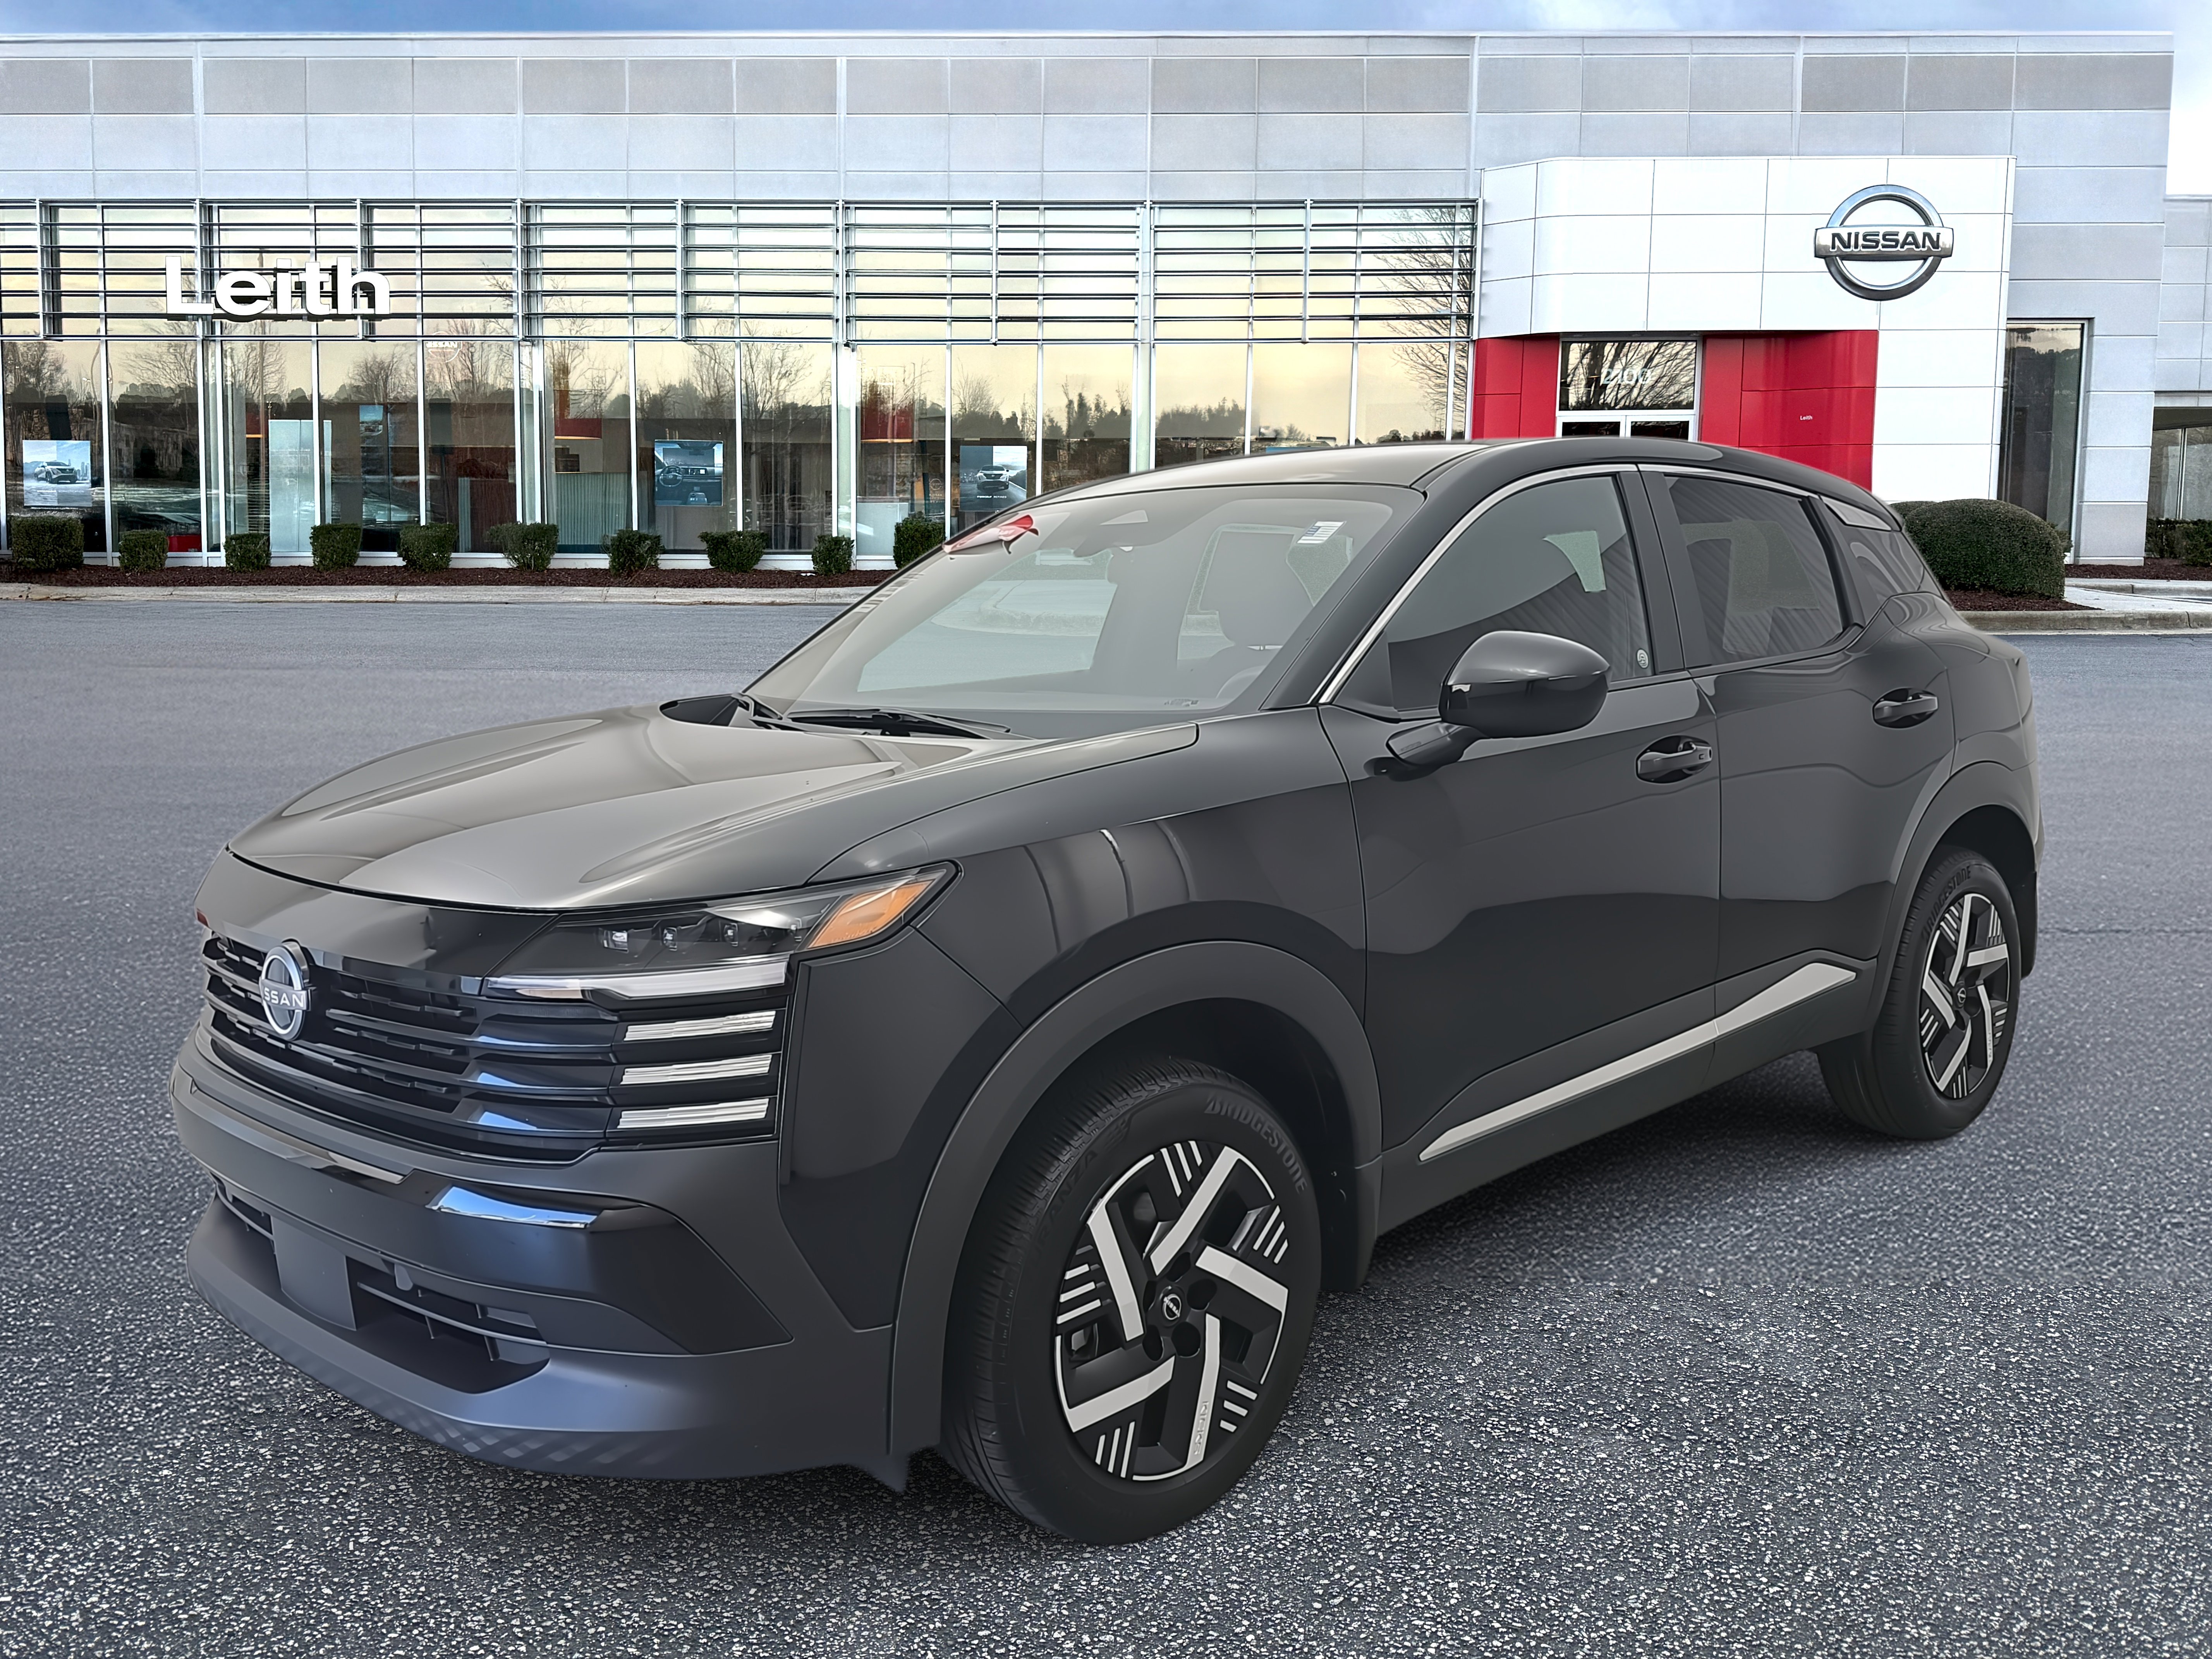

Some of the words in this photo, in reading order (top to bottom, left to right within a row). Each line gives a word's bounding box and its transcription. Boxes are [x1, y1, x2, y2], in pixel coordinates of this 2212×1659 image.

[1831, 232, 1941, 250] NISSAN
[165, 256, 390, 316] Leith
[264, 987, 304, 1007] SSAN
